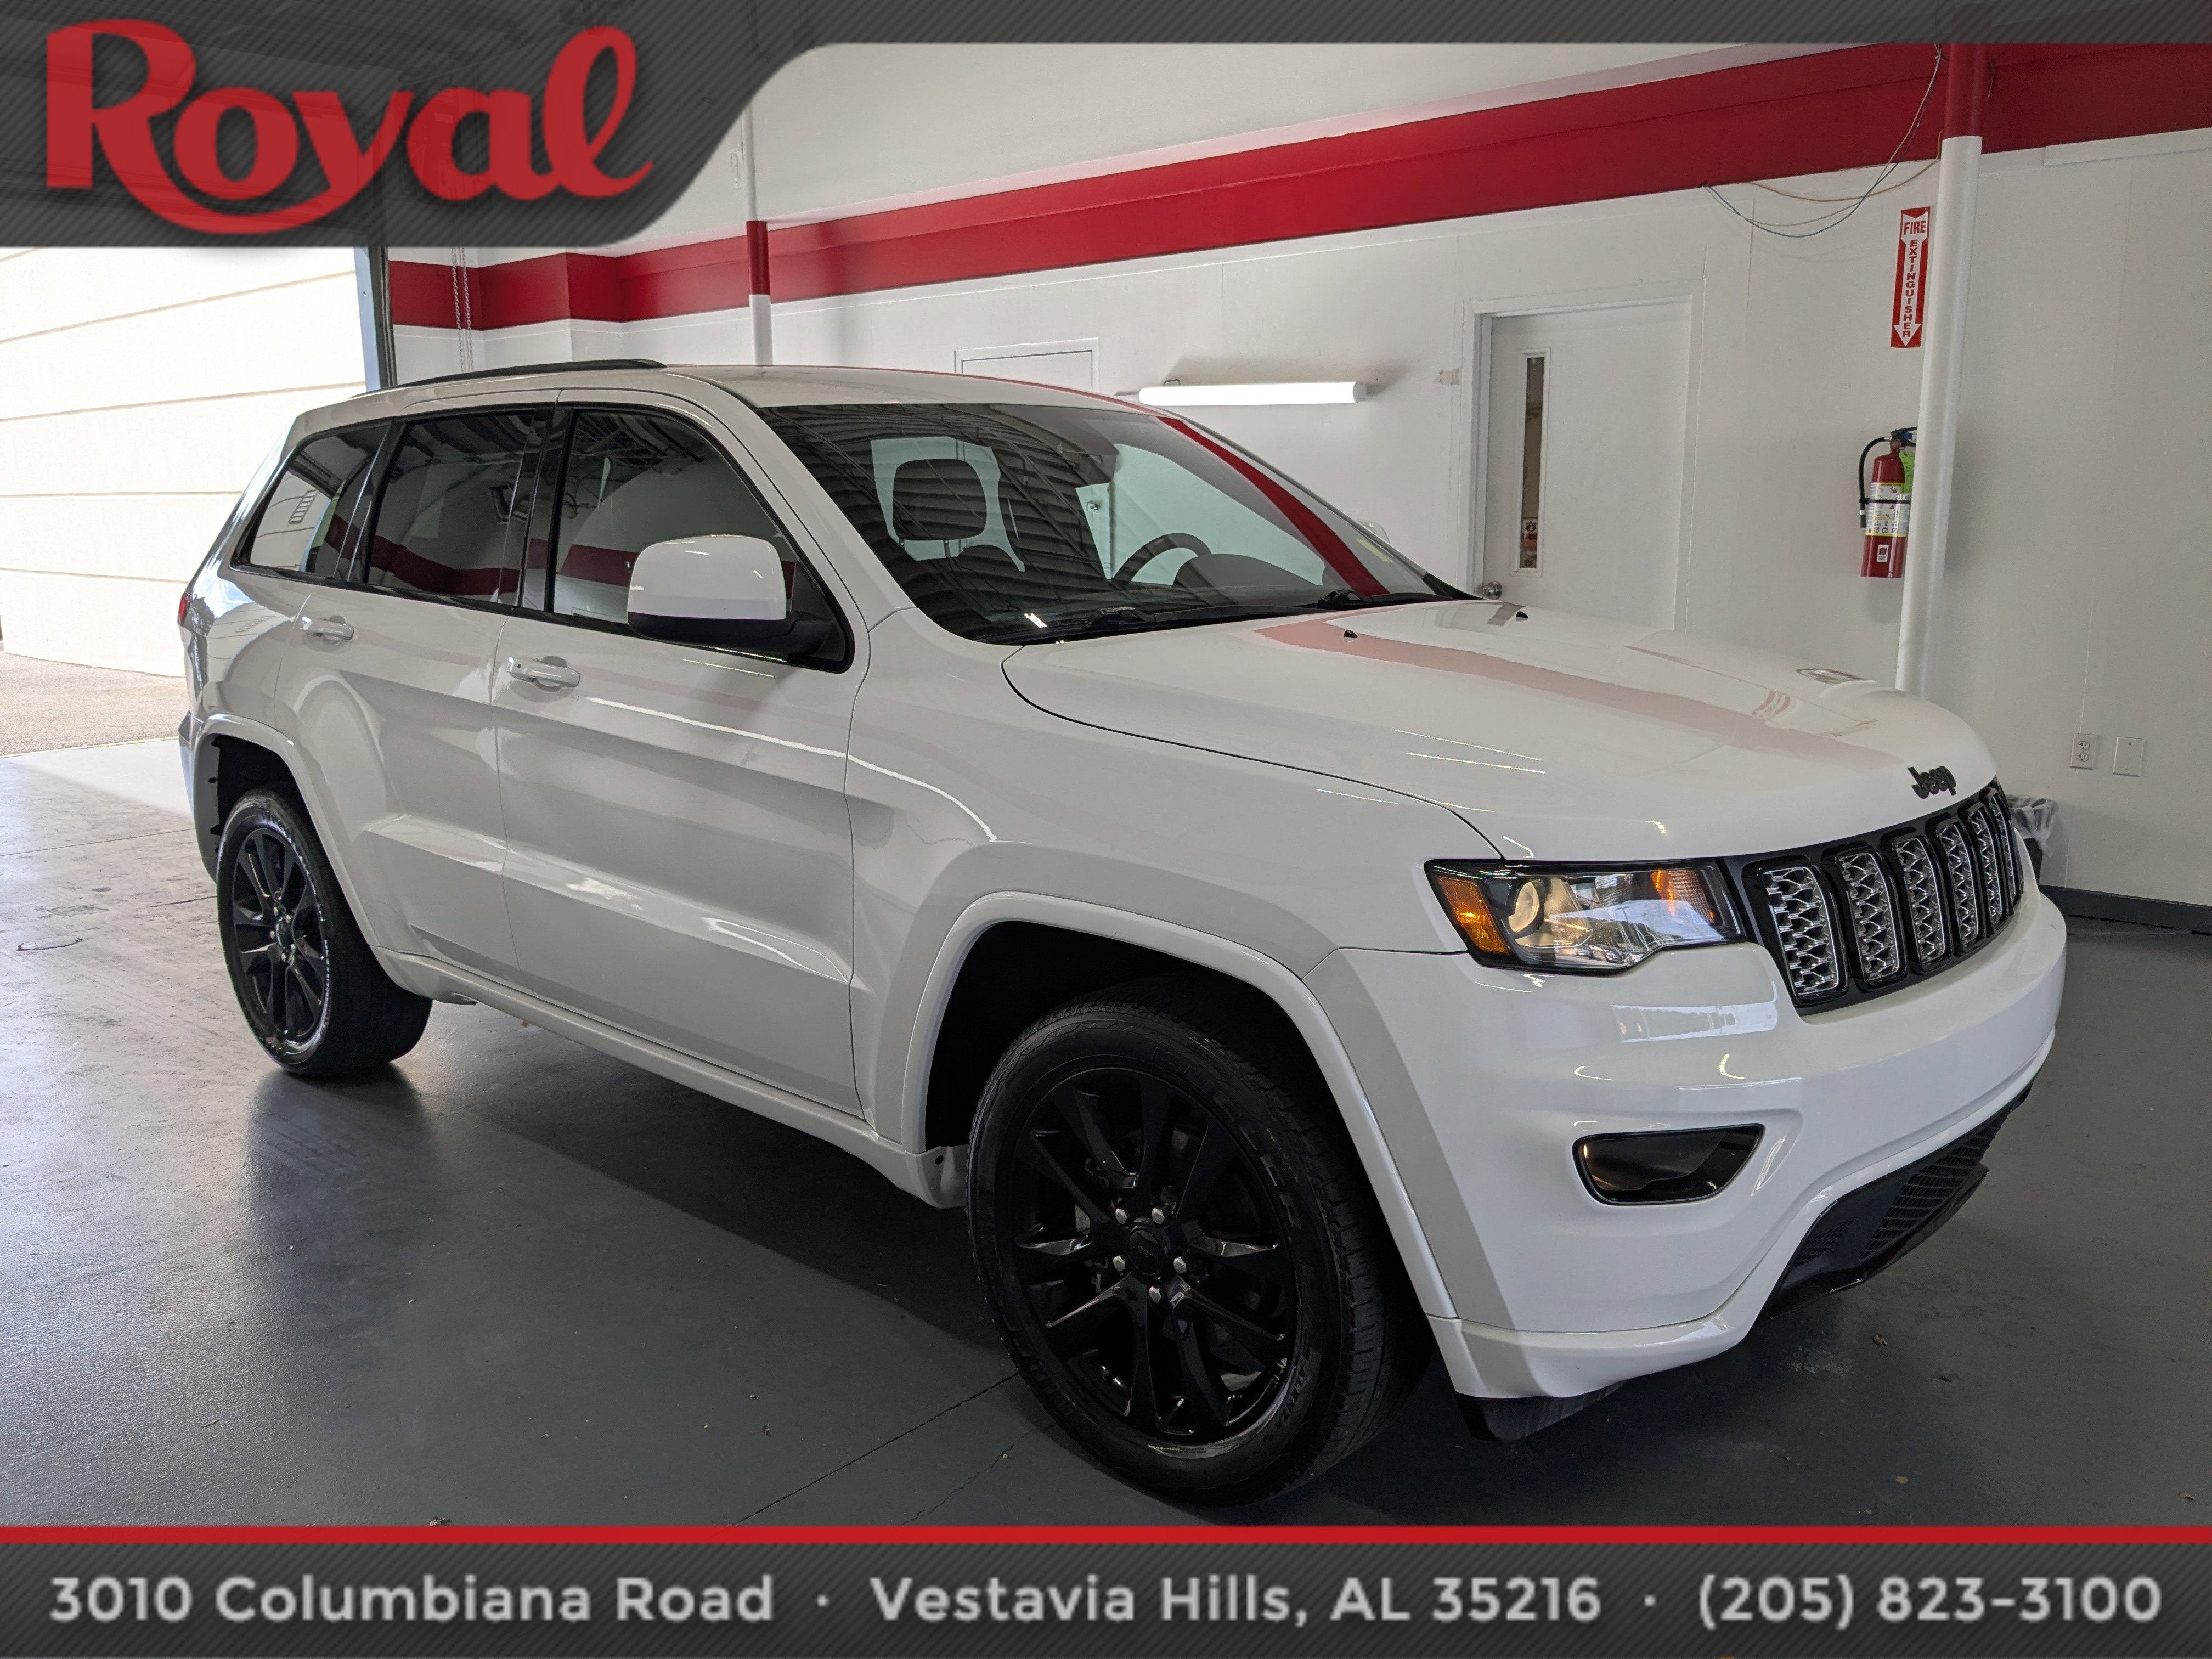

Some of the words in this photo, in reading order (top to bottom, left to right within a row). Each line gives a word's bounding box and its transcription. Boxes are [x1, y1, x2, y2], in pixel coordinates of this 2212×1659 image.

[1903, 221, 1926, 235] FIRE
[1902, 239, 1918, 338] EXTINGUISHER
[1908, 766, 1957, 799] Jeep
